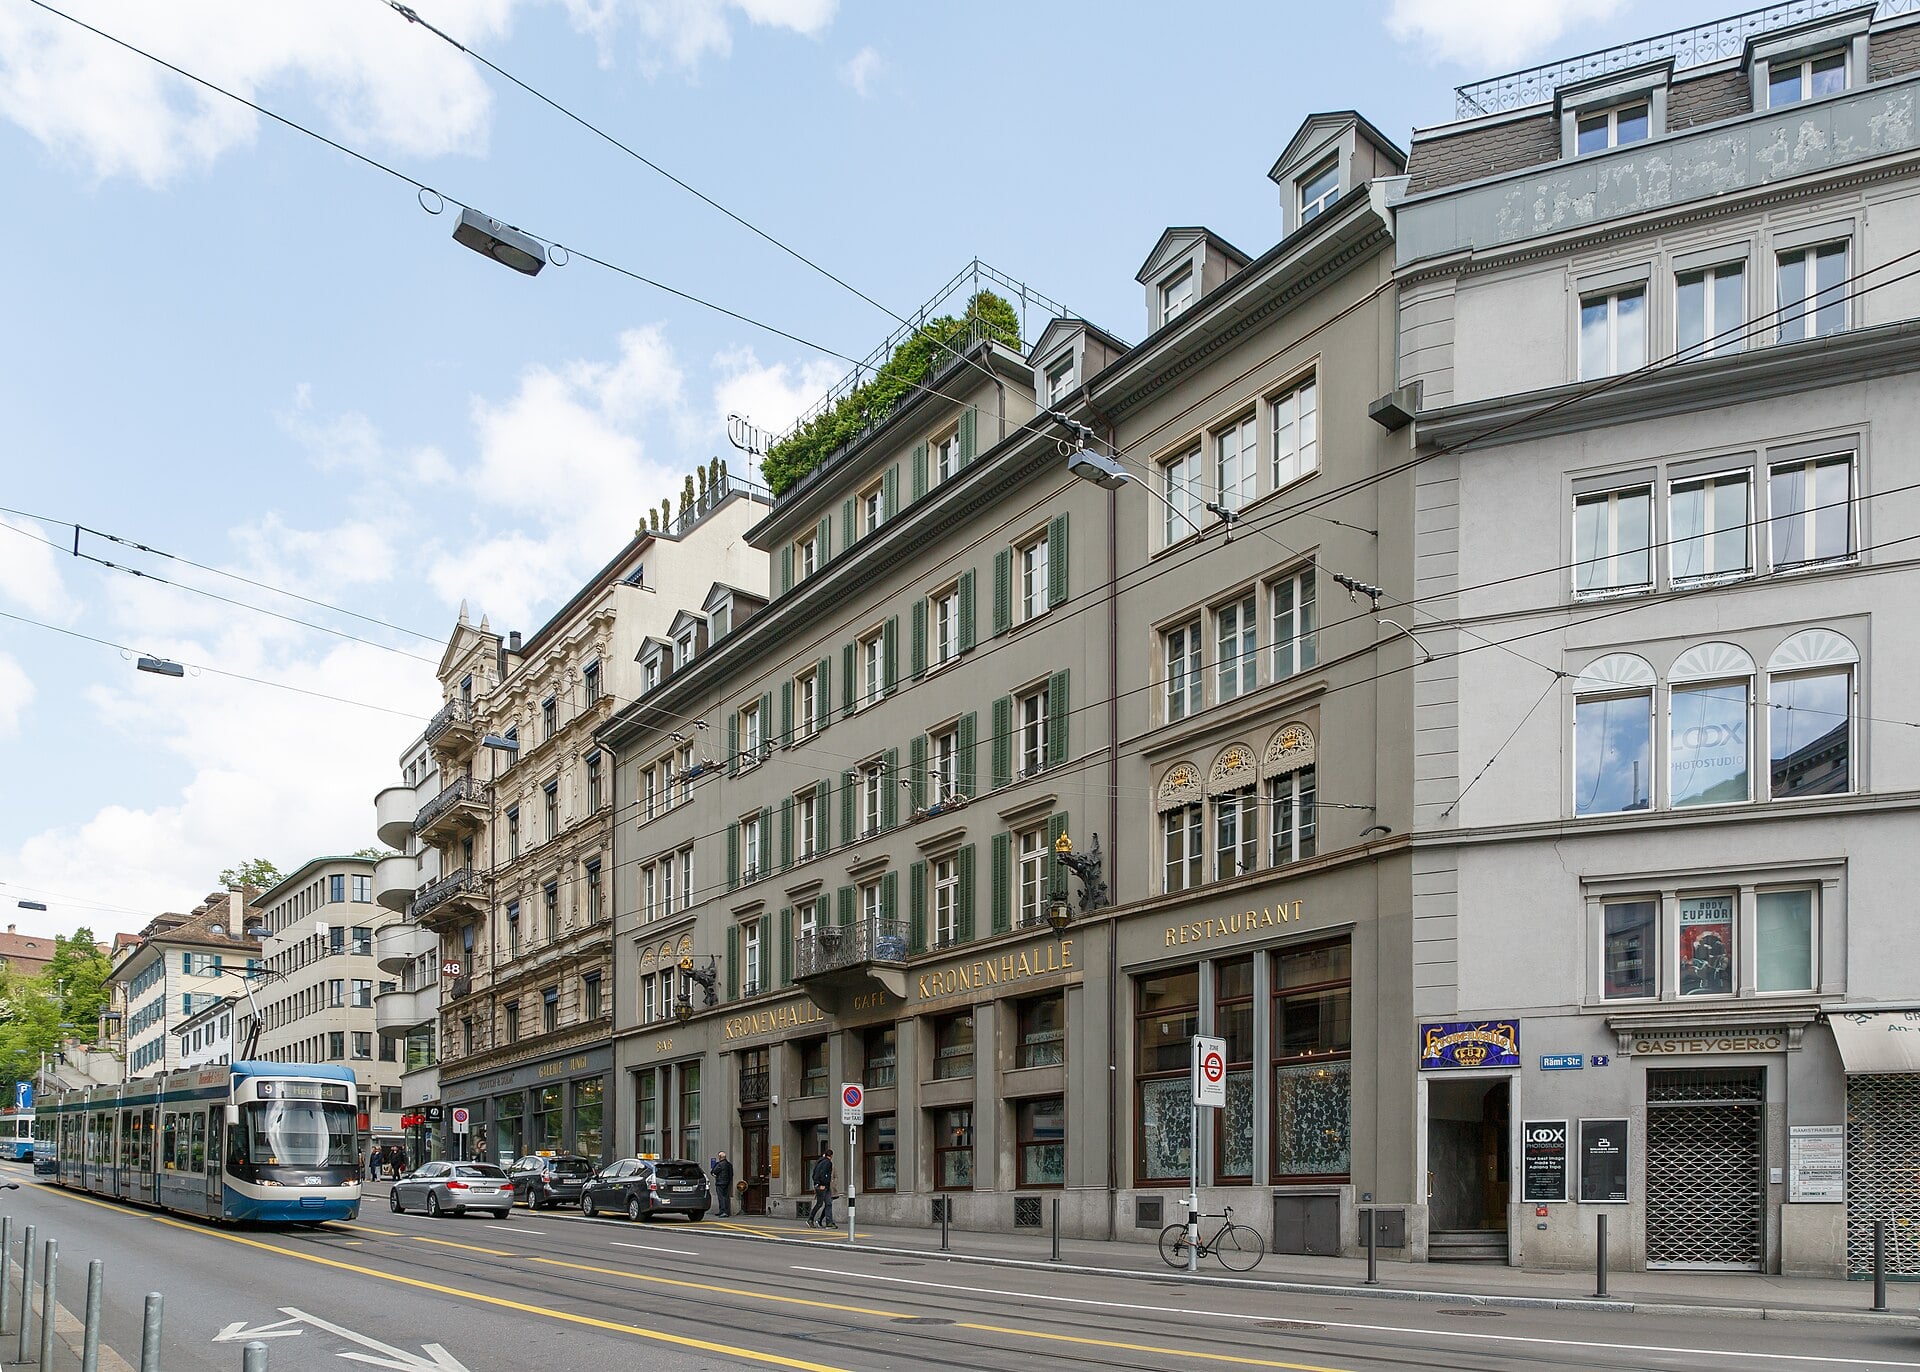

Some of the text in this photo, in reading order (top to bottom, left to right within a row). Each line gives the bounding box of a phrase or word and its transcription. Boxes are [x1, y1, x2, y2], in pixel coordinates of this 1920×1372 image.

[1165, 900, 1303, 947] RESTAURANT
[443, 963, 460, 975] 48
[919, 940, 1074, 999] KRONENHALLE
[725, 1001, 824, 1040] KRONENHALLE
[656, 1039, 673, 1053] BAR
[1597, 1056, 1603, 1065] 2
[538, 1061, 563, 1078] GALERIE
[265, 1085, 272, 1094] 9
[1526, 1129, 1564, 1142] LOOX
